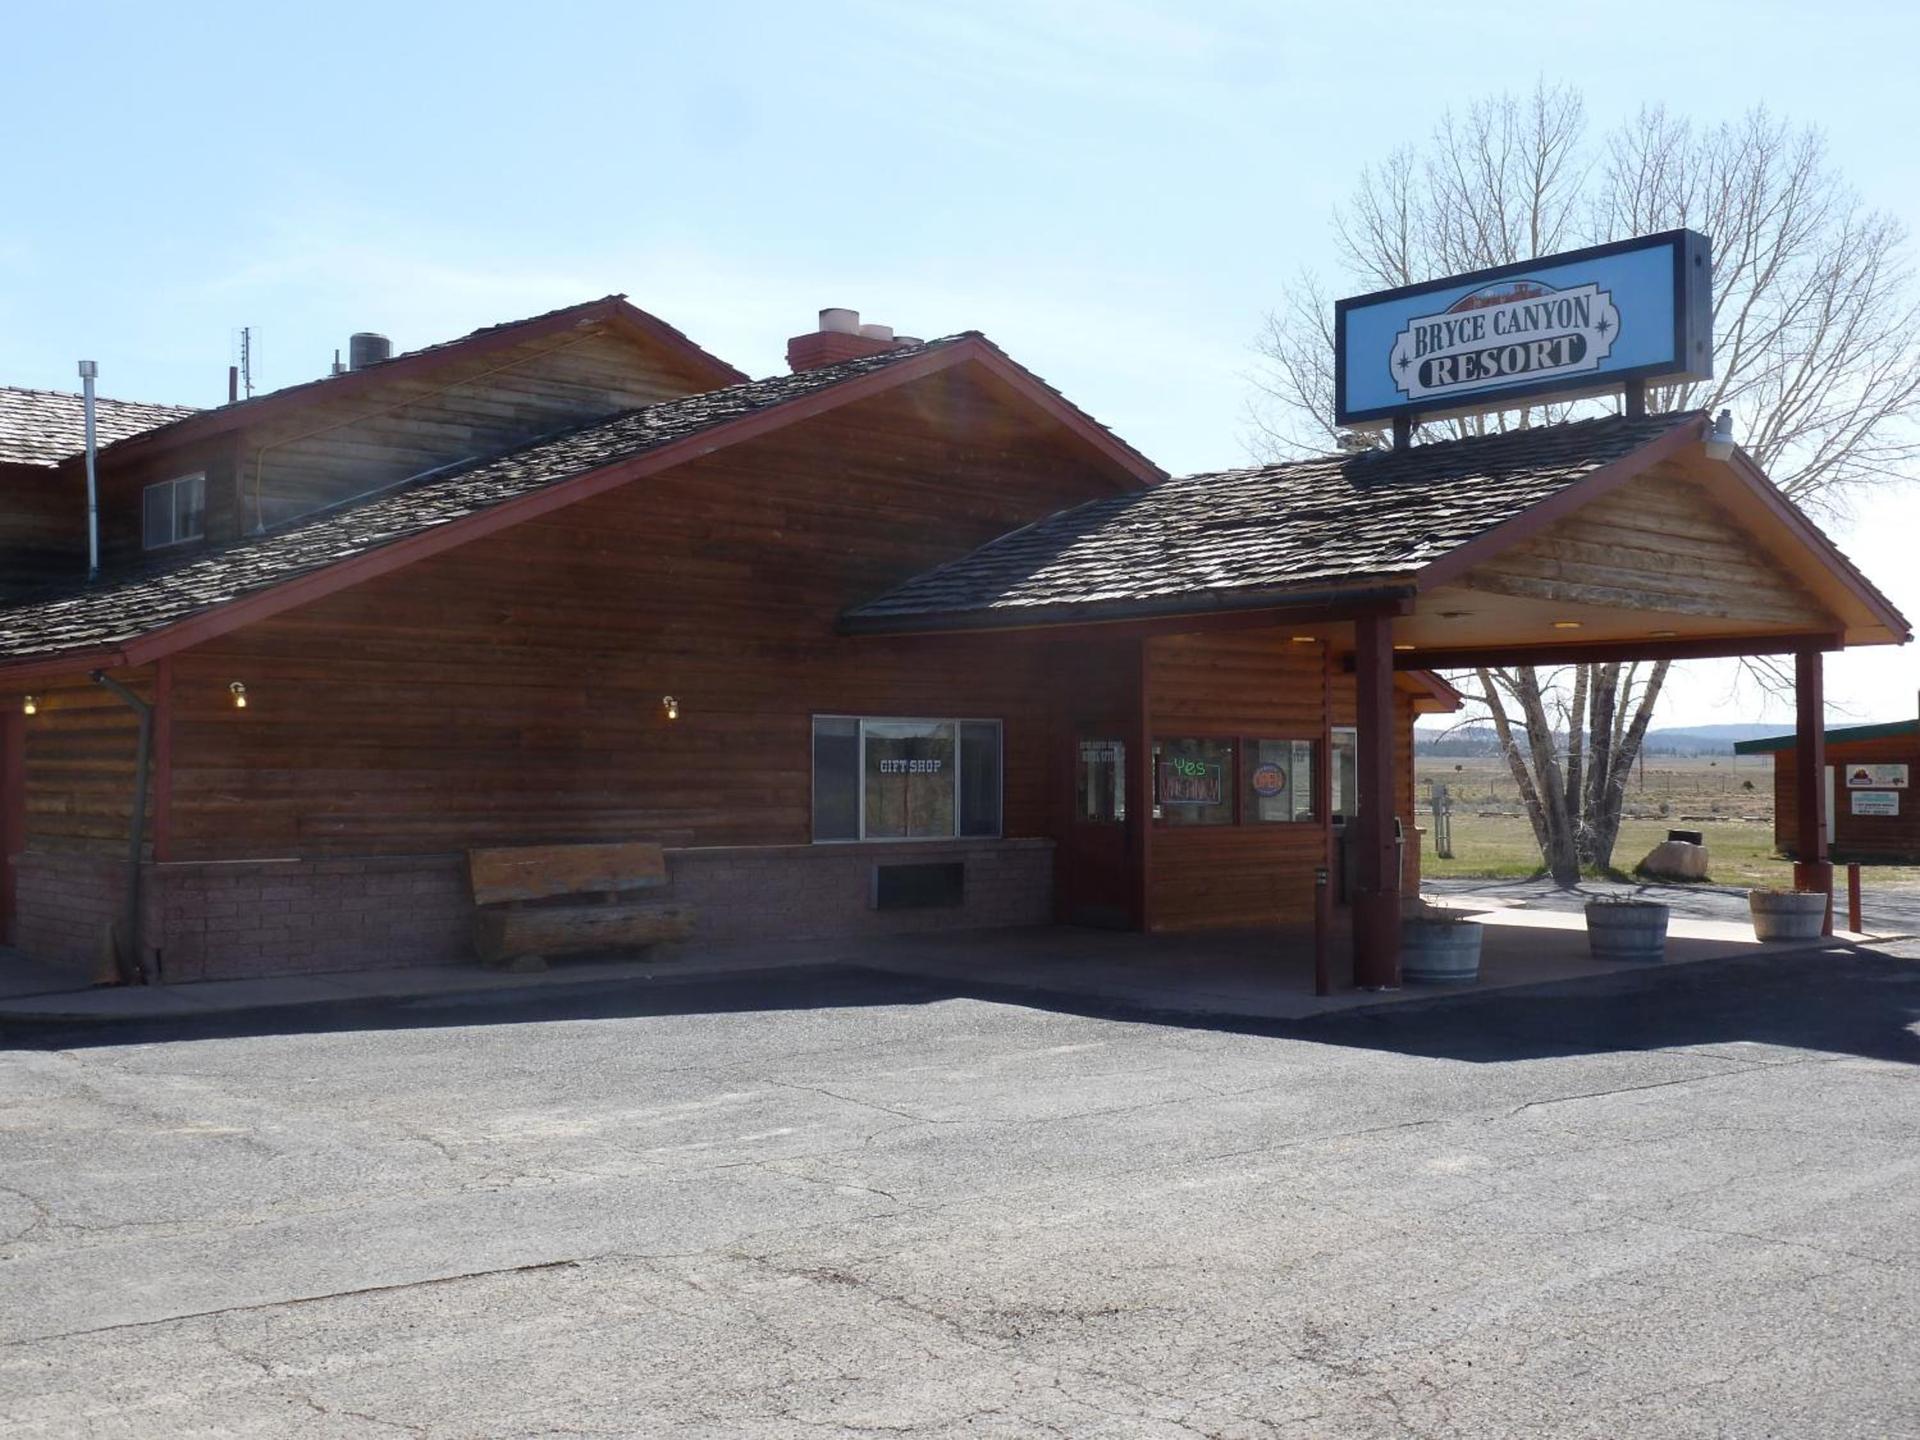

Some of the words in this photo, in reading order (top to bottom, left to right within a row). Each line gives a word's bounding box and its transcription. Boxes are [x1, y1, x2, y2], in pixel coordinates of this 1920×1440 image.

[1414, 315, 1485, 358] BRYCE
[1493, 295, 1591, 335] CANYON
[1430, 335, 1578, 386] RESORT
[880, 759, 907, 773] GIFT
[909, 759, 941, 773] SHOP
